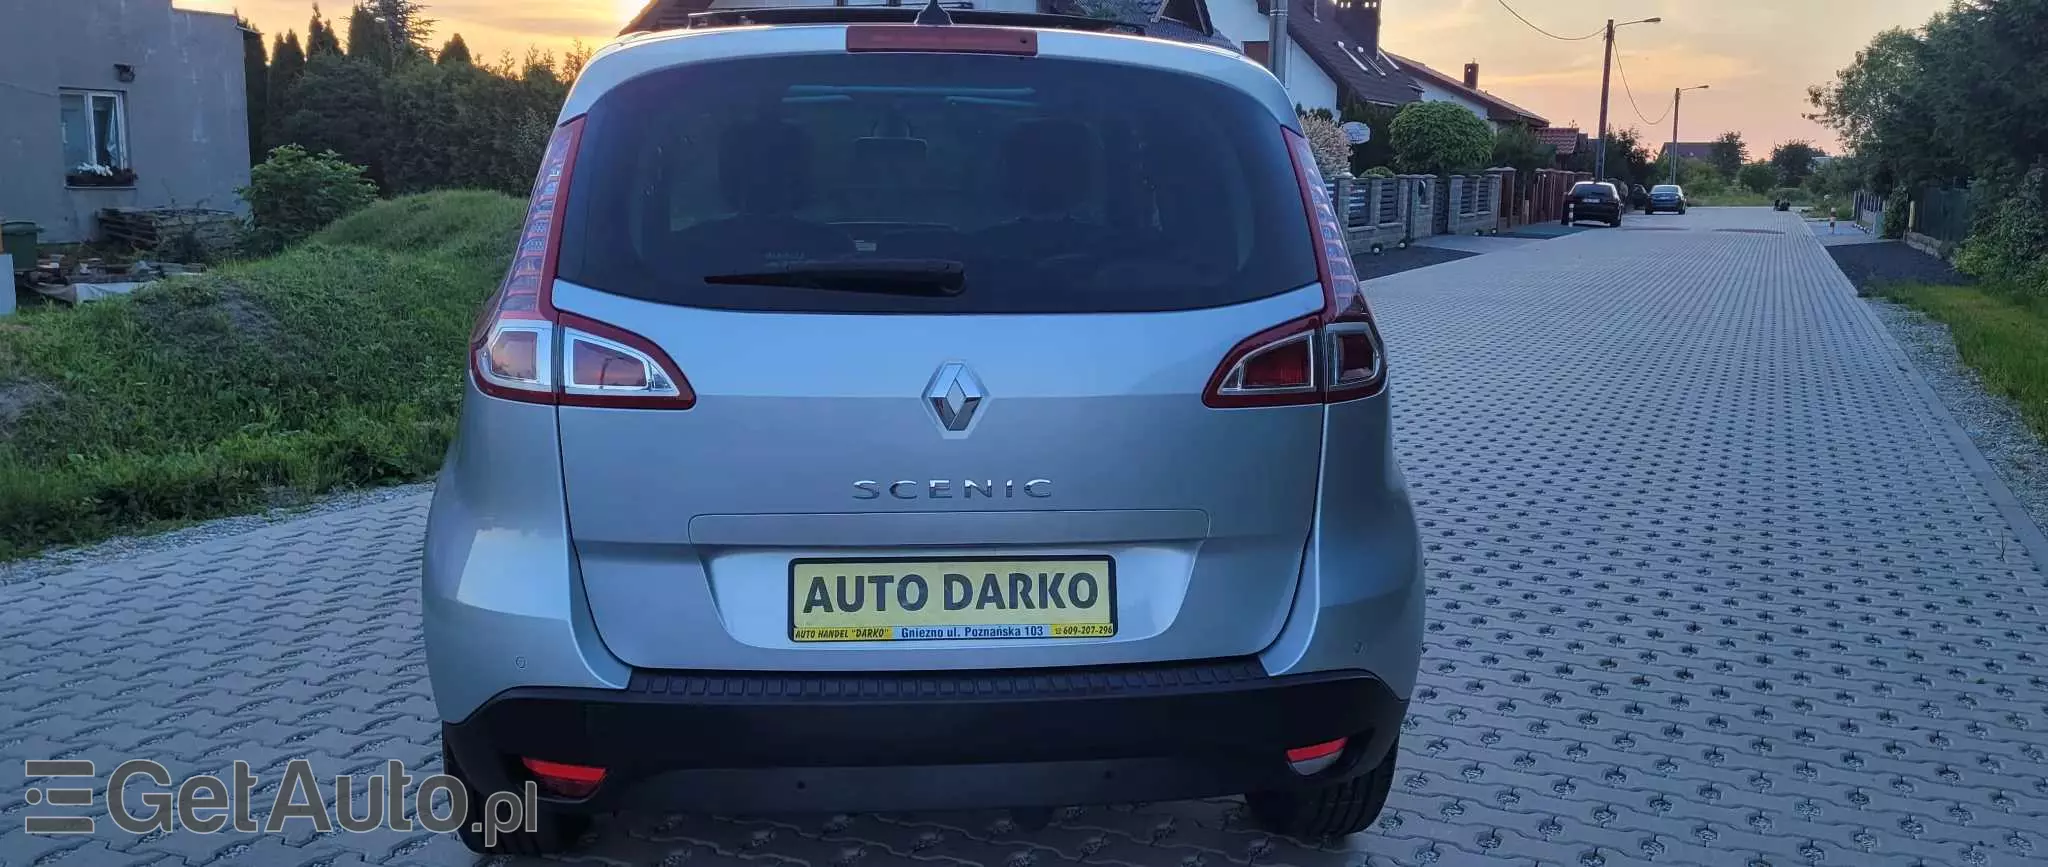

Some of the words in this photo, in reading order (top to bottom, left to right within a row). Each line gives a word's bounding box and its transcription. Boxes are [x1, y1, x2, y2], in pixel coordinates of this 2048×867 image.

[852, 479, 1053, 500] SCENIC
[803, 574, 928, 613] AUTO
[943, 571, 1098, 611] DARKO
[795, 629, 815, 639] AUTO
[817, 629, 848, 639] HANDEL
[851, 628, 889, 638] "DARKO"
[901, 627, 943, 638] Gniezno
[946, 626, 961, 637] ul.
[964, 625, 1021, 637] Poznańska
[1024, 626, 1043, 636] 103
